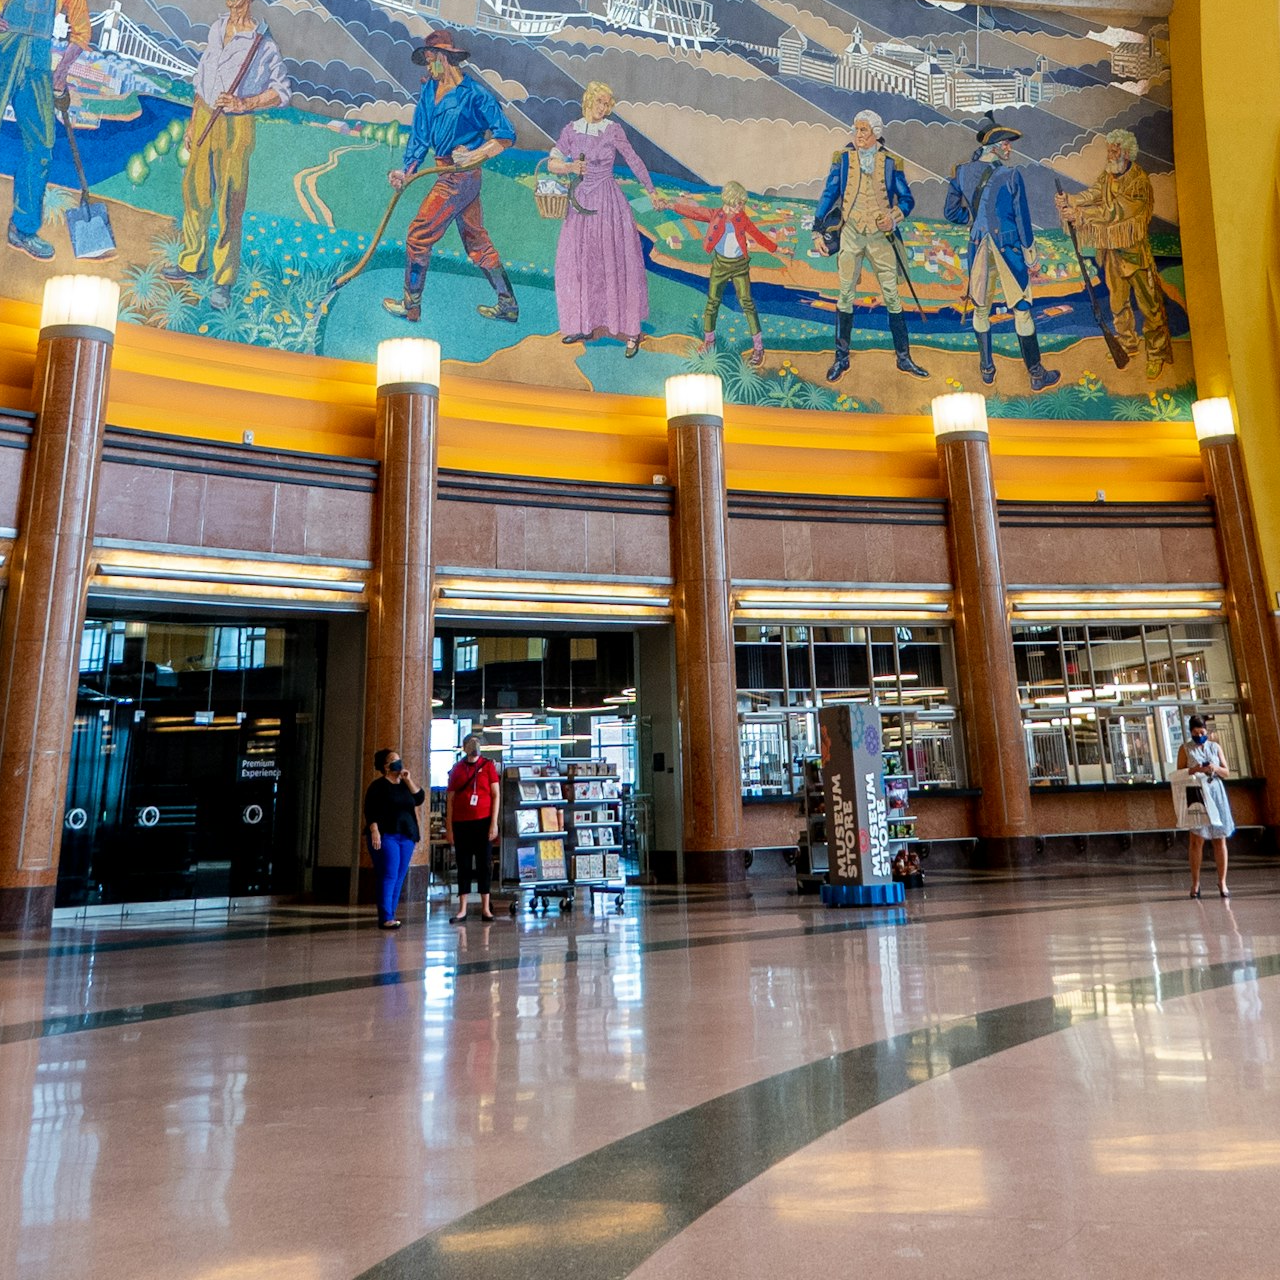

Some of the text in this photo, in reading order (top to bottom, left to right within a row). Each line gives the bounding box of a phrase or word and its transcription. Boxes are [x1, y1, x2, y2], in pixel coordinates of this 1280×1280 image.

[241, 768, 282, 779] Experience
[242, 759, 275, 768] Premium
[831, 773, 848, 878] MUSEUM
[843, 800, 858, 878] STORE
[865, 772, 882, 877] MUSEUM
[876, 799, 891, 877] STORE
